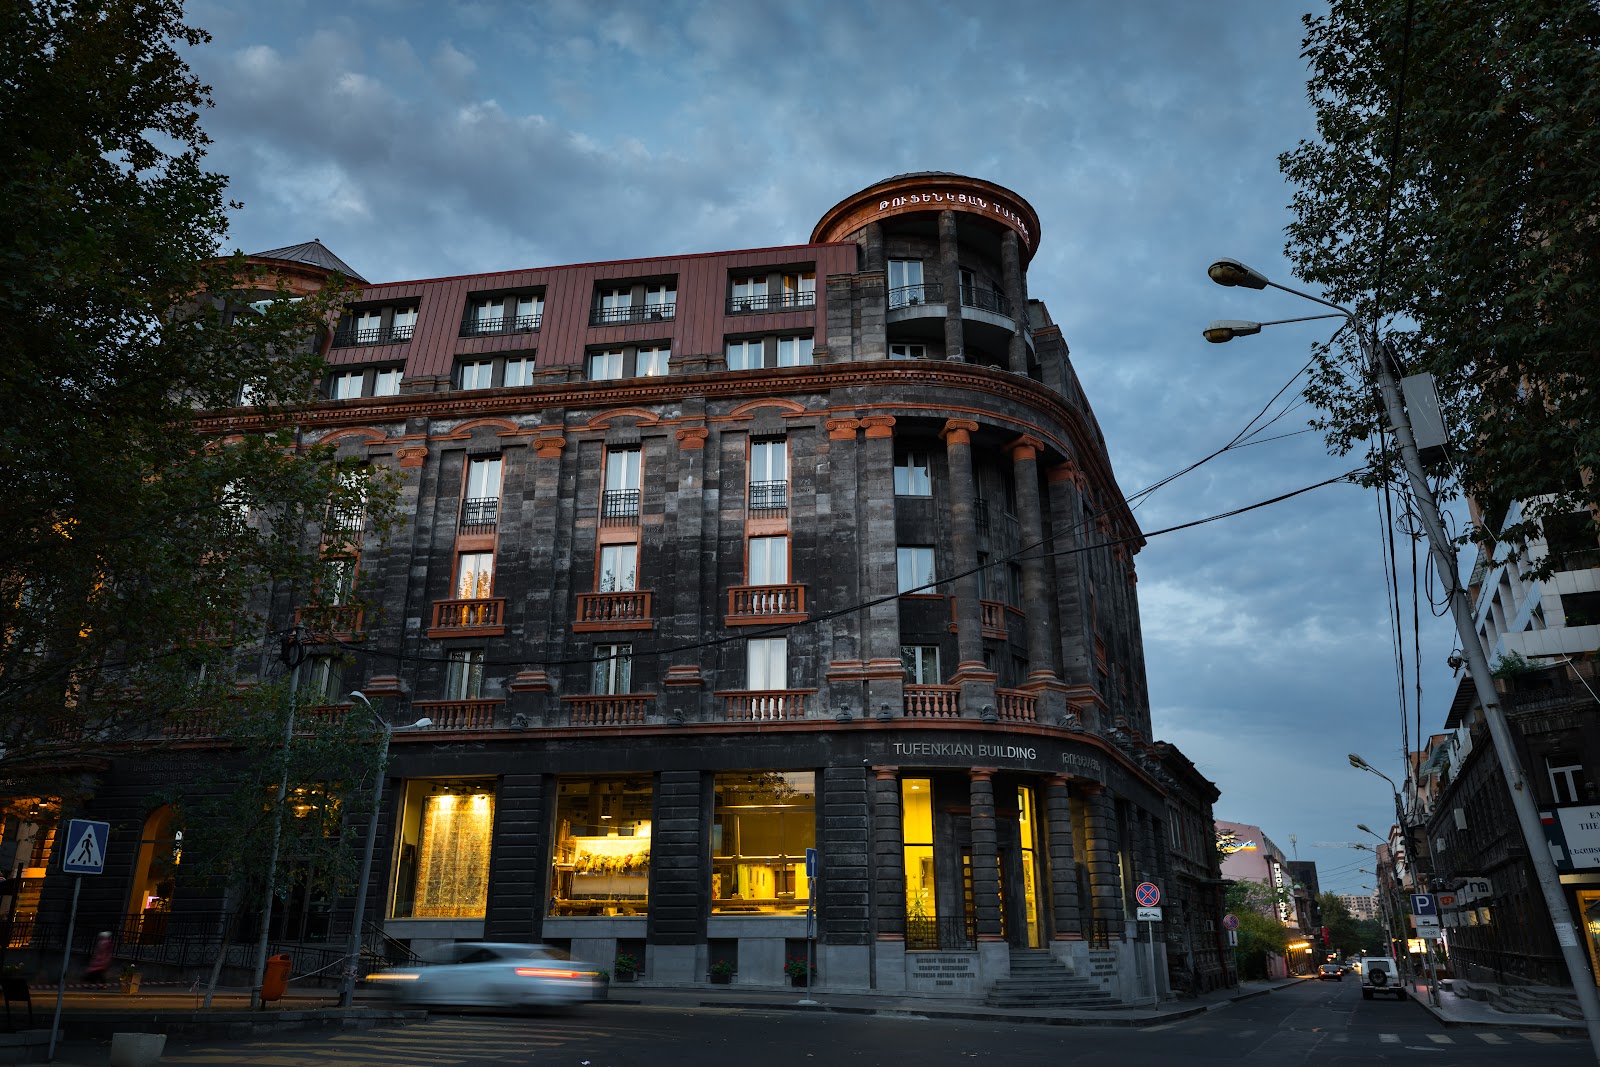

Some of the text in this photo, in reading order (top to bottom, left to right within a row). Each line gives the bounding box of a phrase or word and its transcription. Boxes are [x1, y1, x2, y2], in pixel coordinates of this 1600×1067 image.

[879, 193, 987, 211] ԹՈՒՖԵՆԿՅԱՆ
[893, 742, 1037, 761] TUFENKIAN BUILDING
[1415, 896, 1429, 914] P
